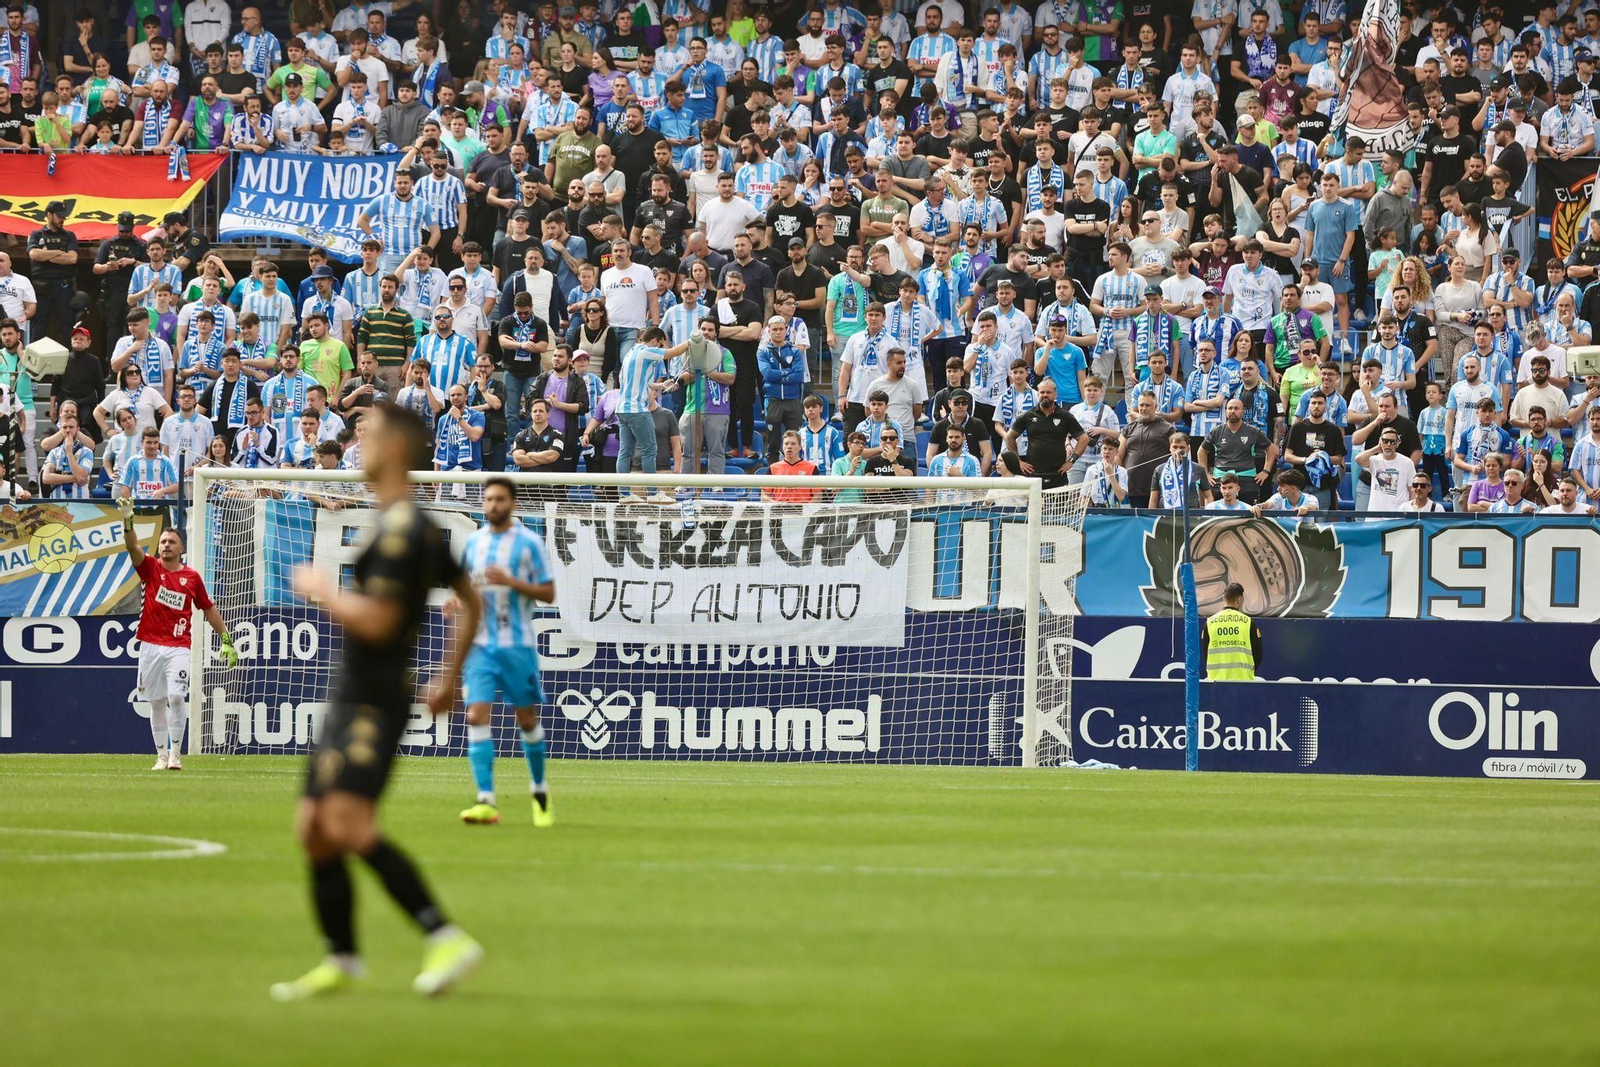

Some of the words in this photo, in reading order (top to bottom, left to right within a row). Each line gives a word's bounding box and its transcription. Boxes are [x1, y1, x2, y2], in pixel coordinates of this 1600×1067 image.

[239, 157, 313, 198] MUY
[321, 162, 398, 201] NOBL
[750, 184, 771, 192] Tivoli
[1555, 187, 1578, 203] EL
[238, 191, 257, 210] Y
[262, 198, 330, 228] MUY
[606, 282, 636, 290] ellesse
[139, 482, 162, 491] Tivoli
[554, 504, 766, 570] FUERZA
[589, 577, 674, 625] DEP
[691, 582, 862, 624] ANTONIO
[1210, 614, 1249, 624] SEGURIDAD
[1217, 627, 1240, 636] 0006
[641, 690, 881, 752] hummel
[1079, 706, 1292, 752] CaixaBank
[1428, 690, 1559, 752] Olin
[1490, 760, 1517, 772] fibra
[1526, 760, 1556, 773] móvil
[1565, 762, 1577, 773] tv
